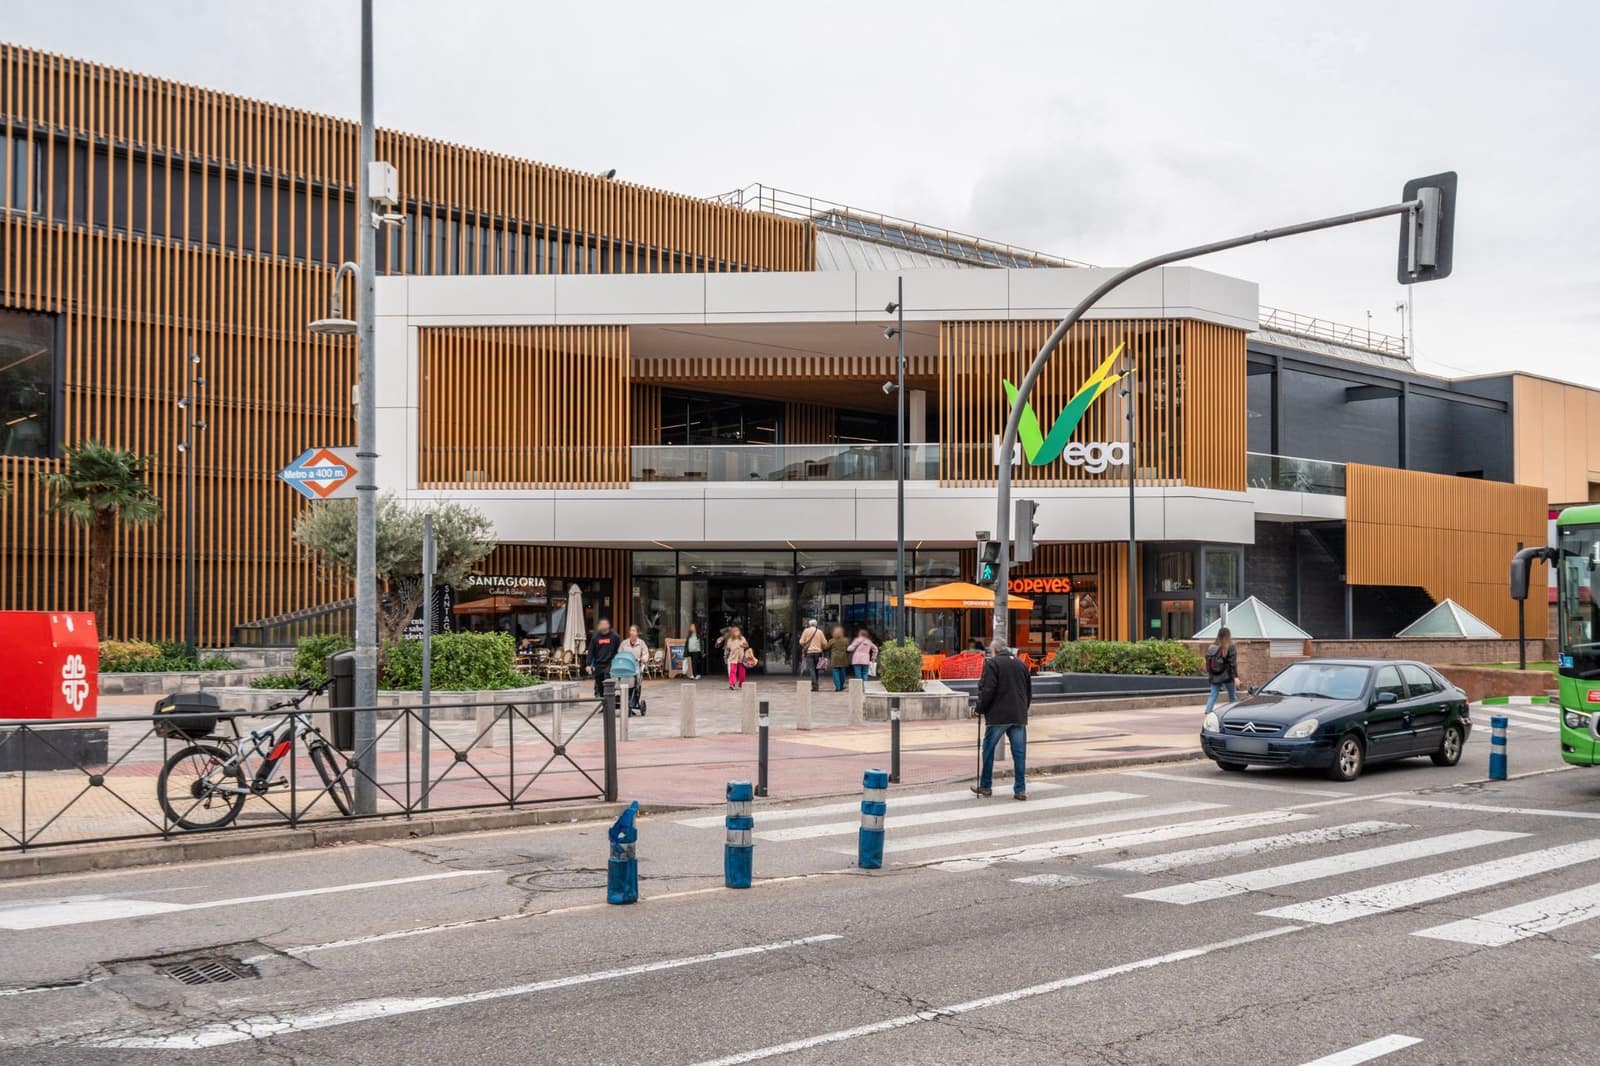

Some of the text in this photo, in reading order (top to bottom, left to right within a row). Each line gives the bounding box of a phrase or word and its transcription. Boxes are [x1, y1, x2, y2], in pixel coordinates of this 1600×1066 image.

[284, 470, 308, 479] Metro
[316, 468, 333, 478] 400
[468, 575, 546, 588] SANTAGLORIA
